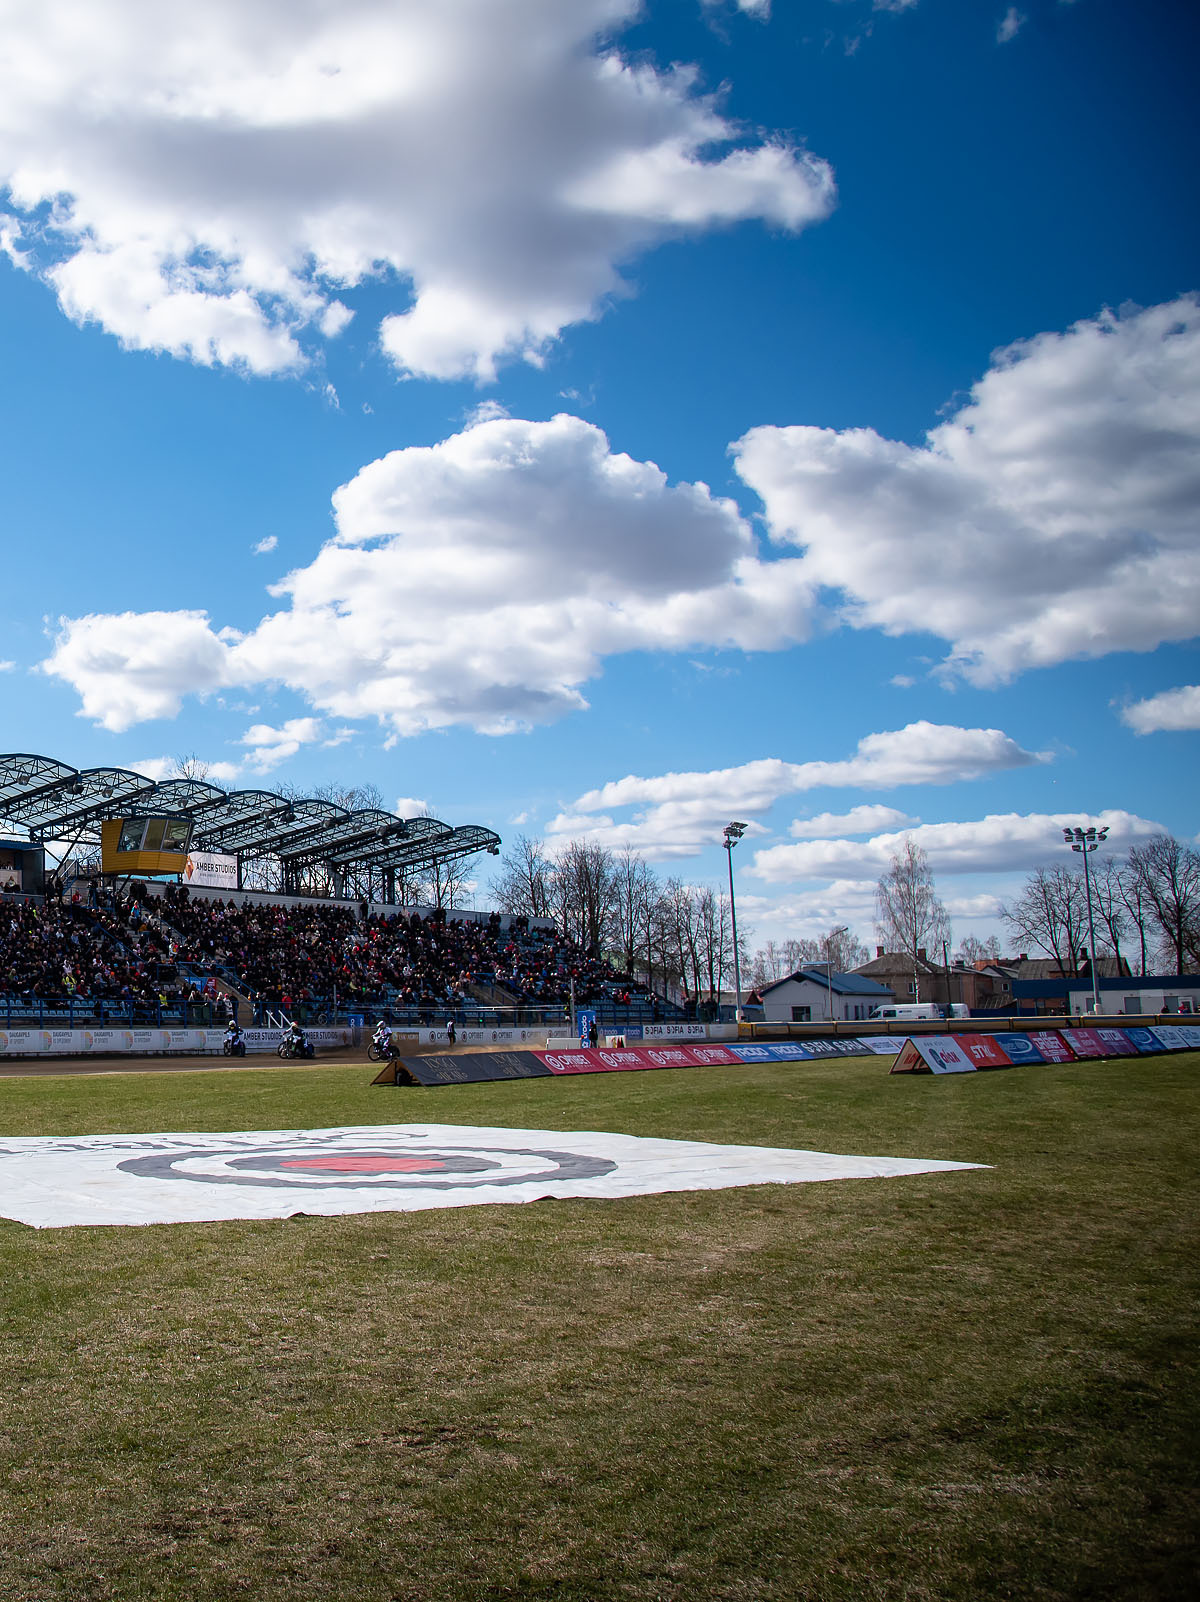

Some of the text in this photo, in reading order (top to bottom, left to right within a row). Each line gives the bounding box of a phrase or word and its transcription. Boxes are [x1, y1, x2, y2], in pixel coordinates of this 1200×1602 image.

[196, 862, 237, 875] AMBER STUDIOS
[243, 1031, 282, 1041] AMBER STUDIOS
[557, 1054, 591, 1065] OPTIBET
